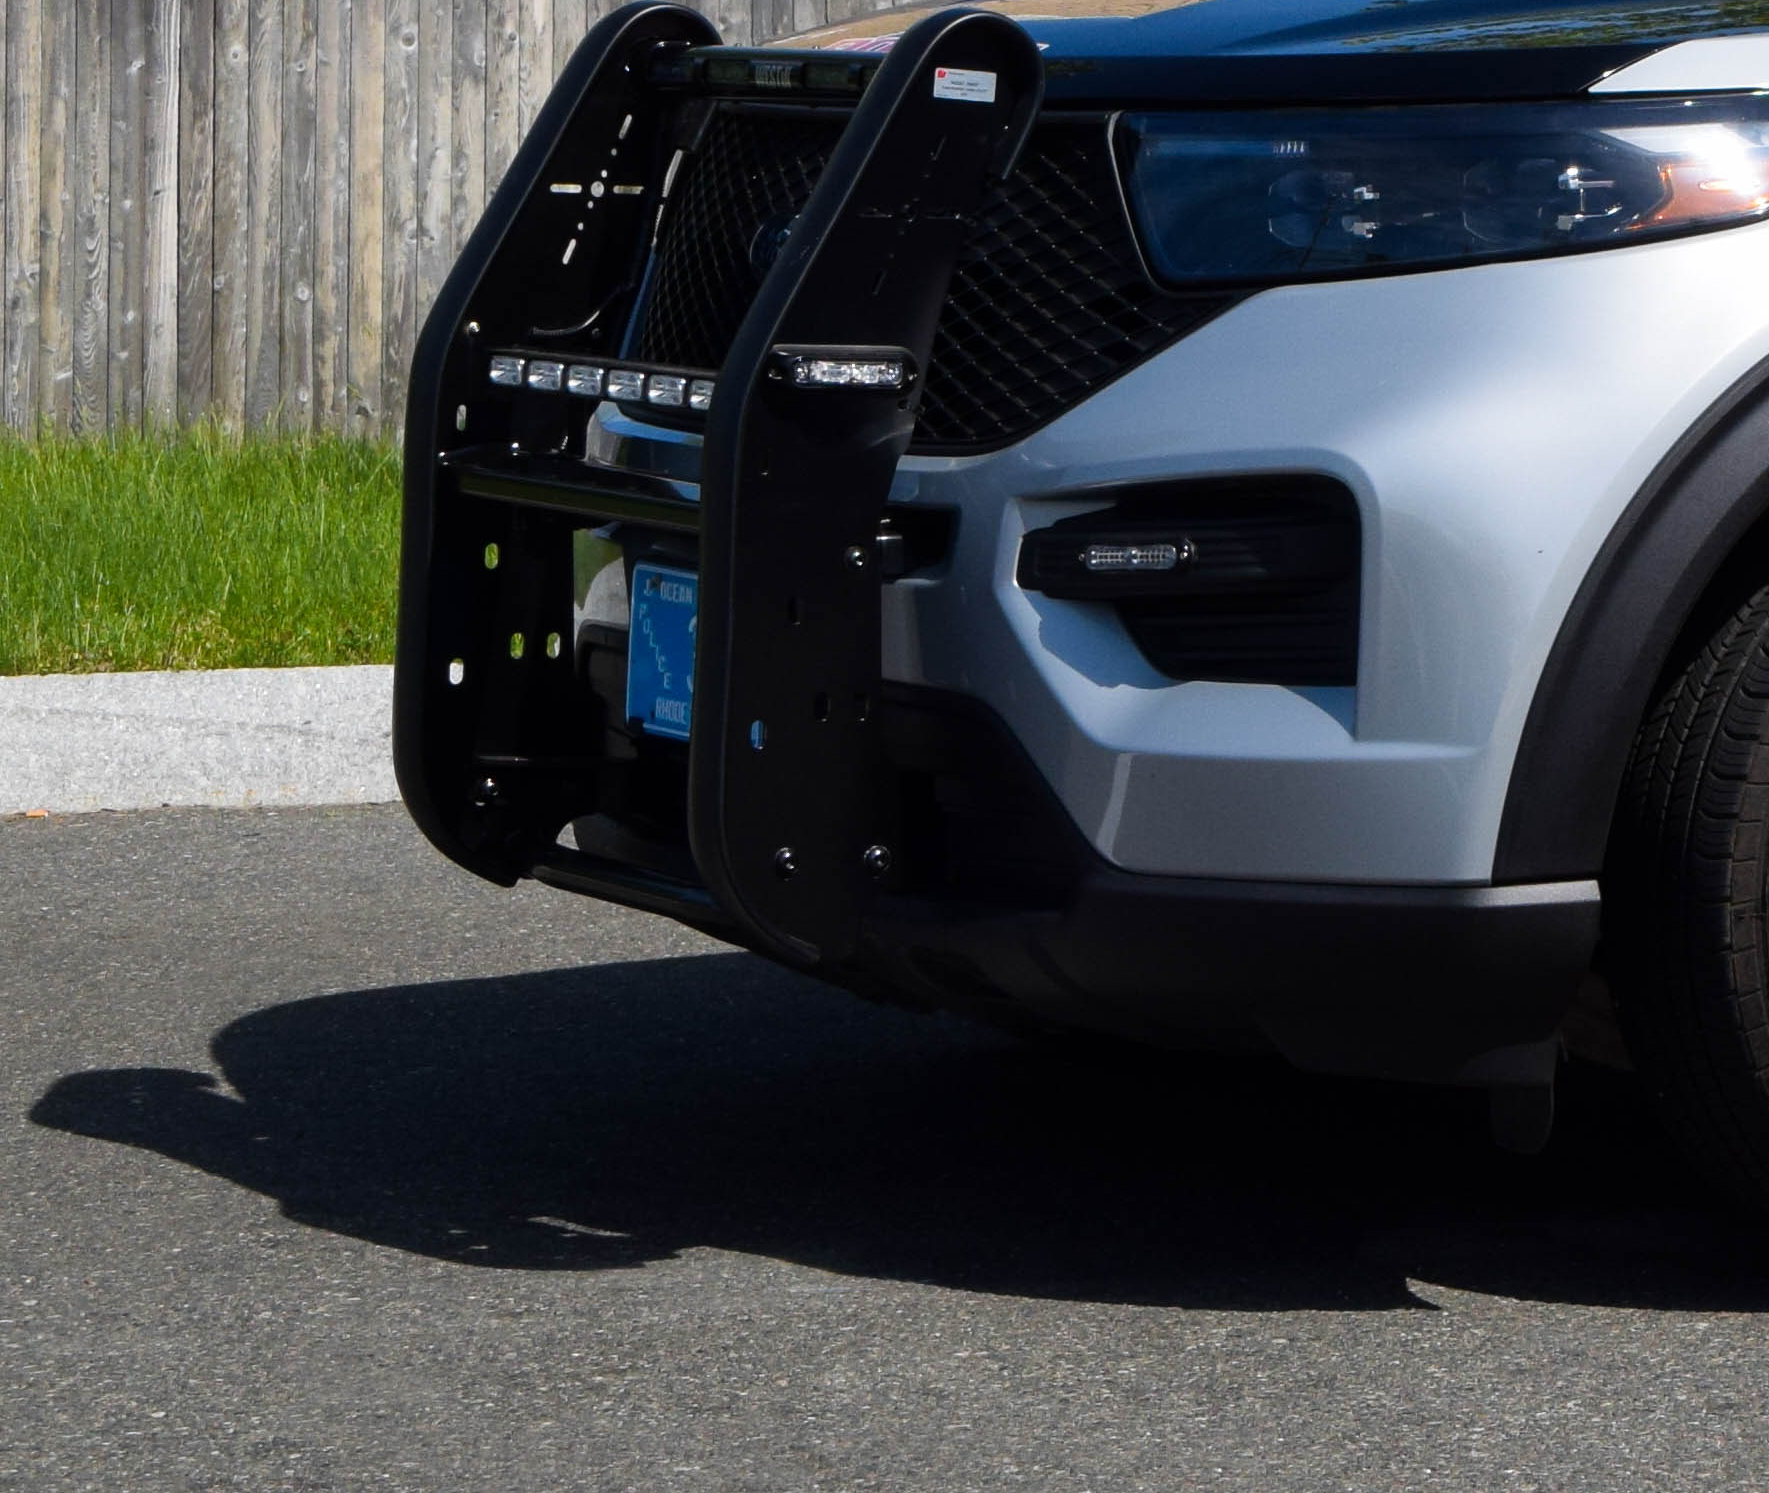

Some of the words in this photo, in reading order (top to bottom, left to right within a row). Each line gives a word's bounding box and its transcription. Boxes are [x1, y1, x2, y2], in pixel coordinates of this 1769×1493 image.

[659, 579, 693, 605] OCEAN
[639, 603, 673, 690] POLICE
[655, 696, 689, 725] RHODE
